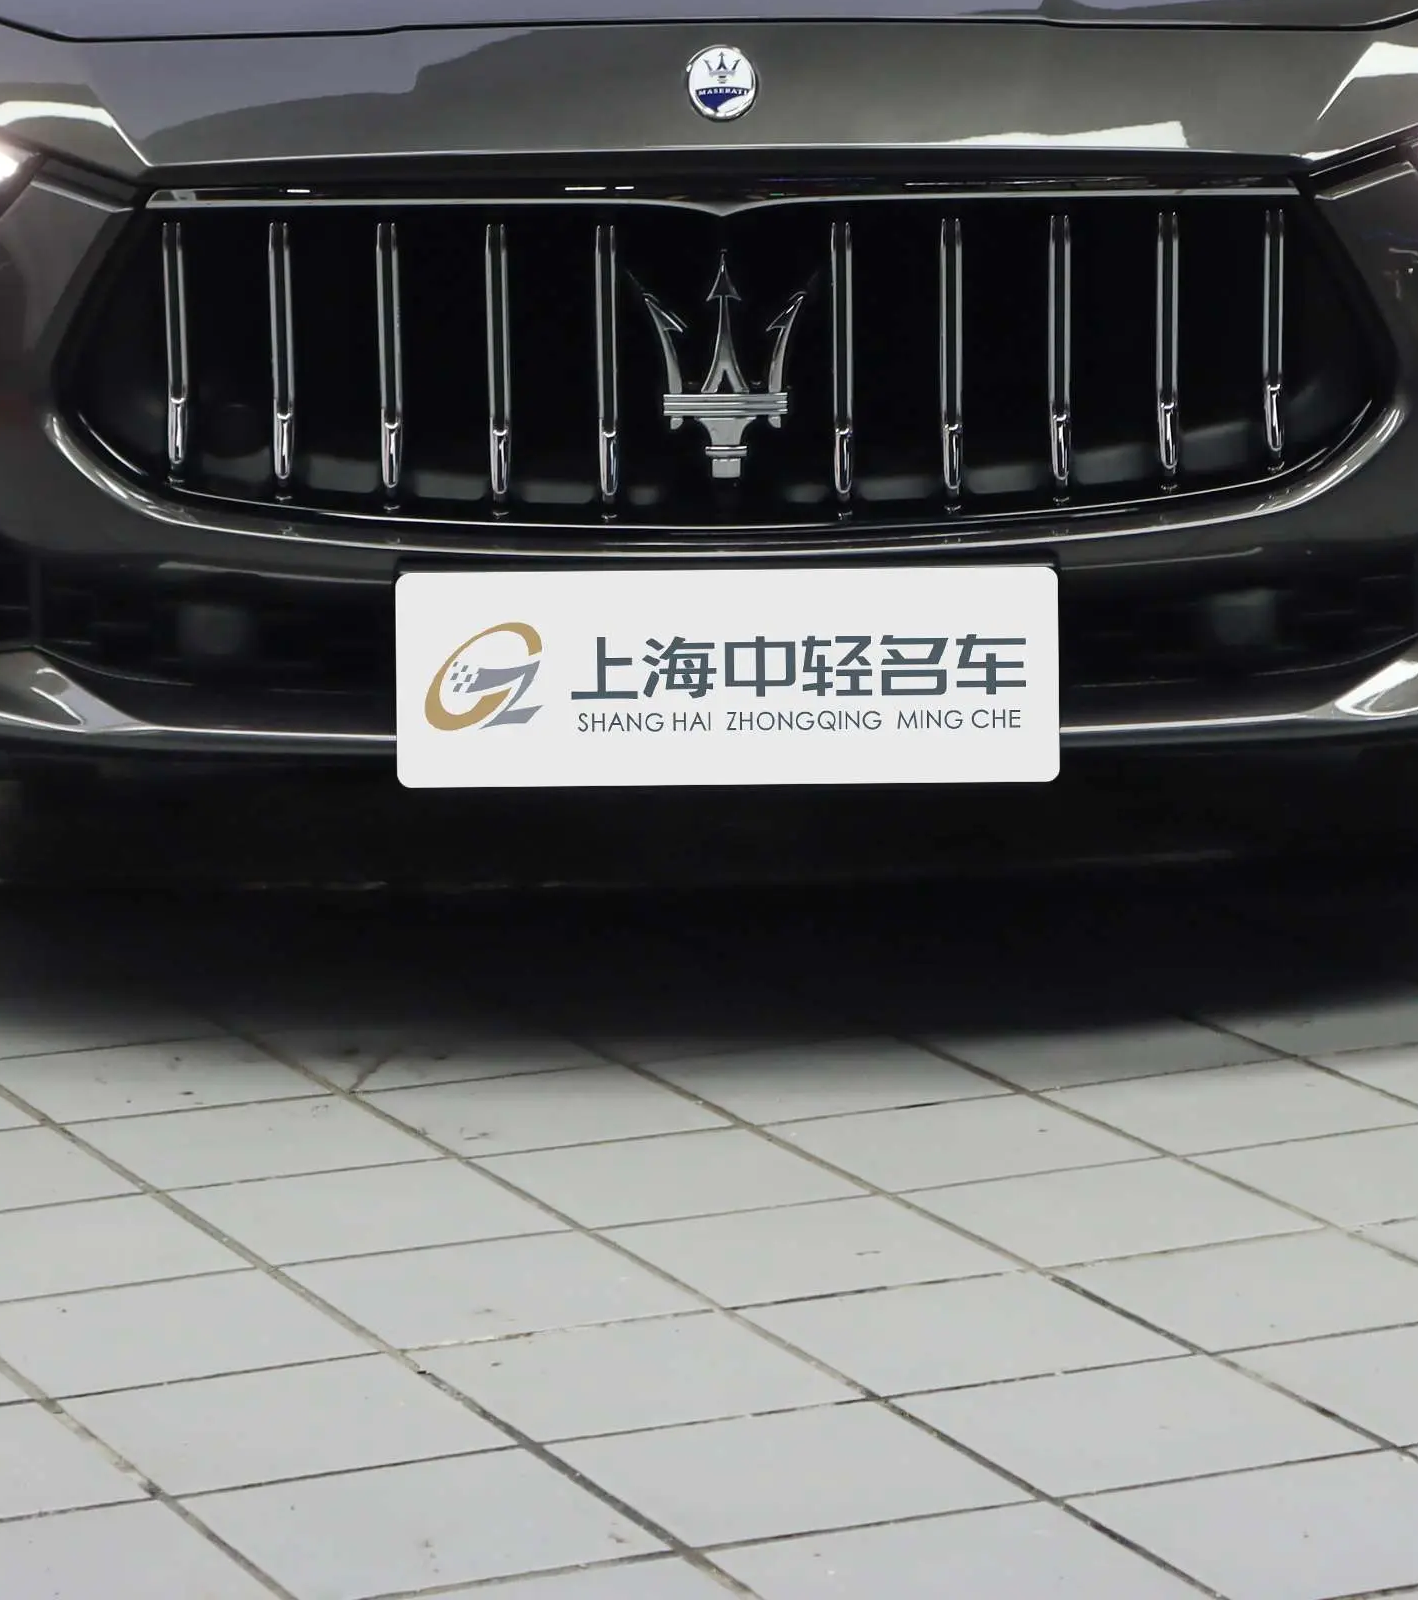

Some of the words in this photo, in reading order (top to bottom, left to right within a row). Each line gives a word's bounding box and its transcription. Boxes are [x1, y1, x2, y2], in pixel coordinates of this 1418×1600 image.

[697, 87, 749, 97] MASERATI
[570, 633, 1027, 701] 上海中轻名车
[577, 712, 665, 733] SHANG
[672, 711, 711, 732] HAI
[726, 710, 882, 732] ZHONGQING
[897, 709, 964, 730] MING
[971, 708, 1021, 729] CHE
